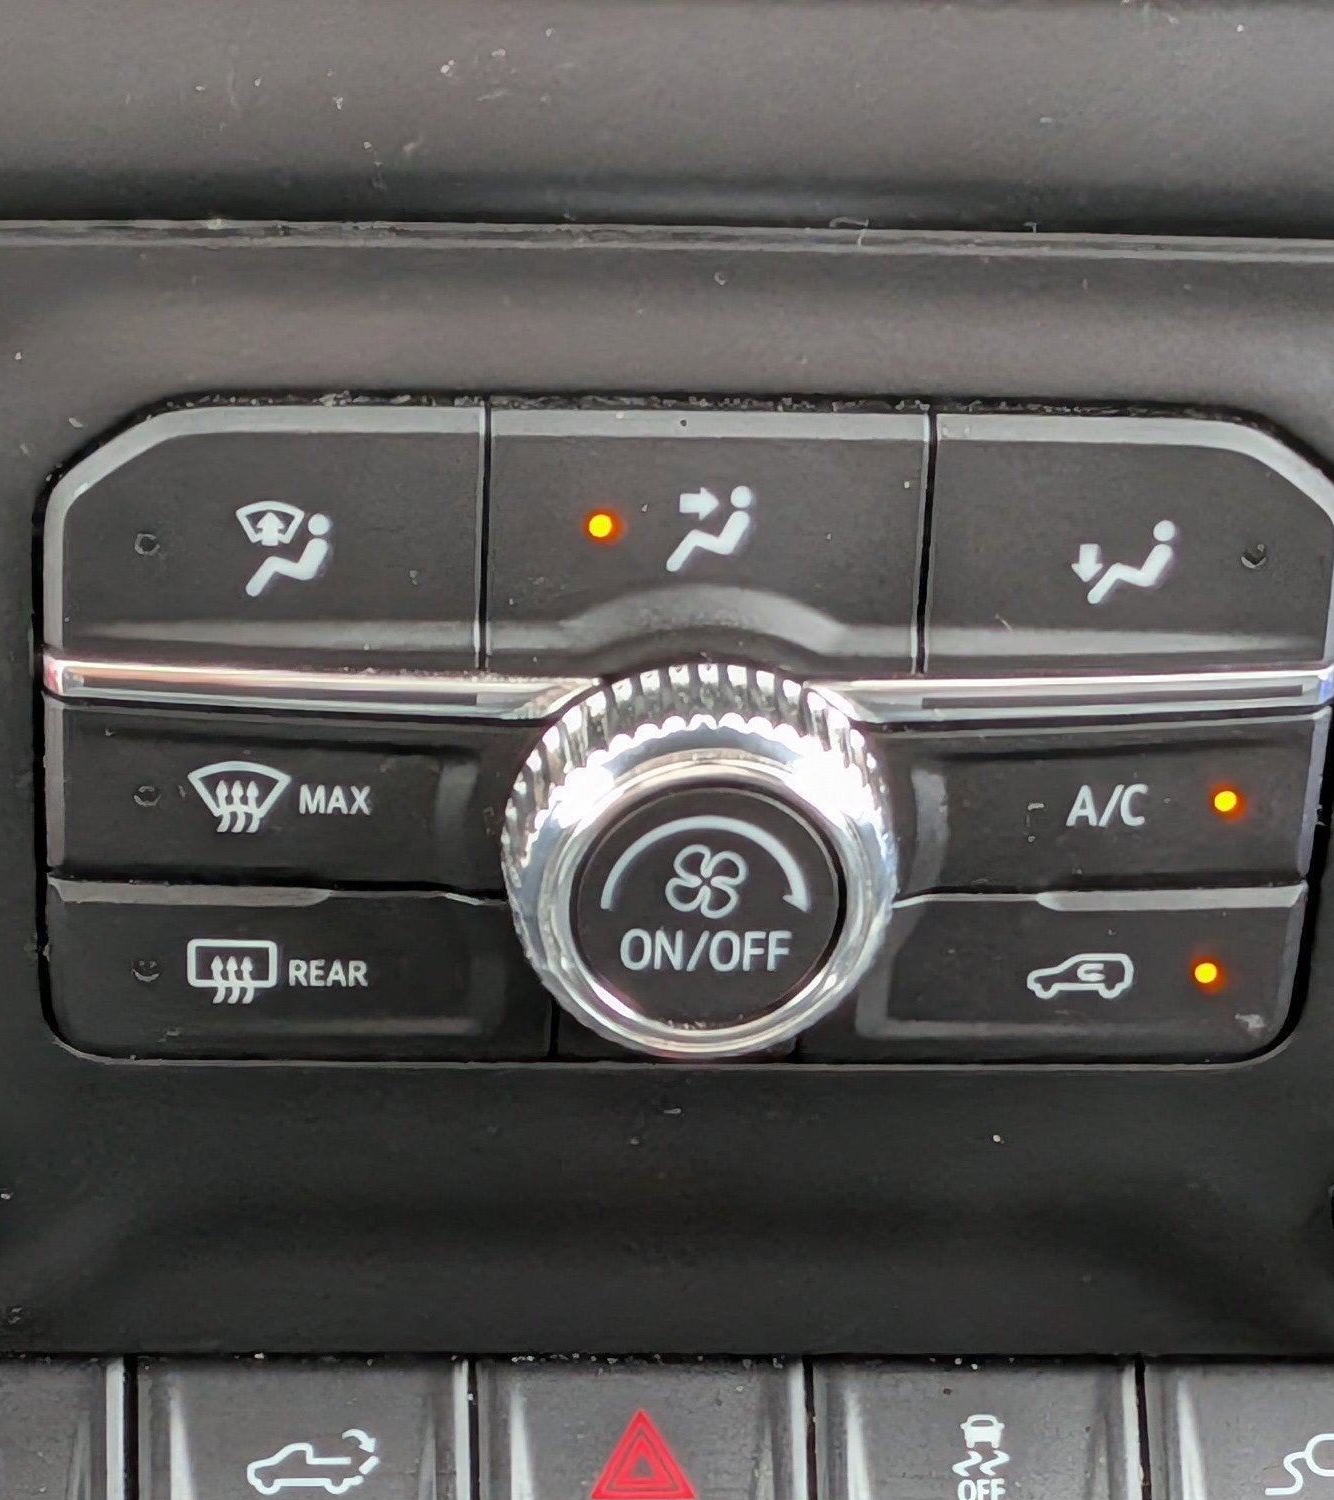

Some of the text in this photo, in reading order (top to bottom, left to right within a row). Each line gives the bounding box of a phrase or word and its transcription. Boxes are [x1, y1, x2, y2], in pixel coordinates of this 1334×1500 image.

[298, 784, 371, 815] MAX
[1065, 783, 1149, 828] A/C
[620, 928, 792, 972] ON/OFF
[288, 959, 368, 987] REAR
